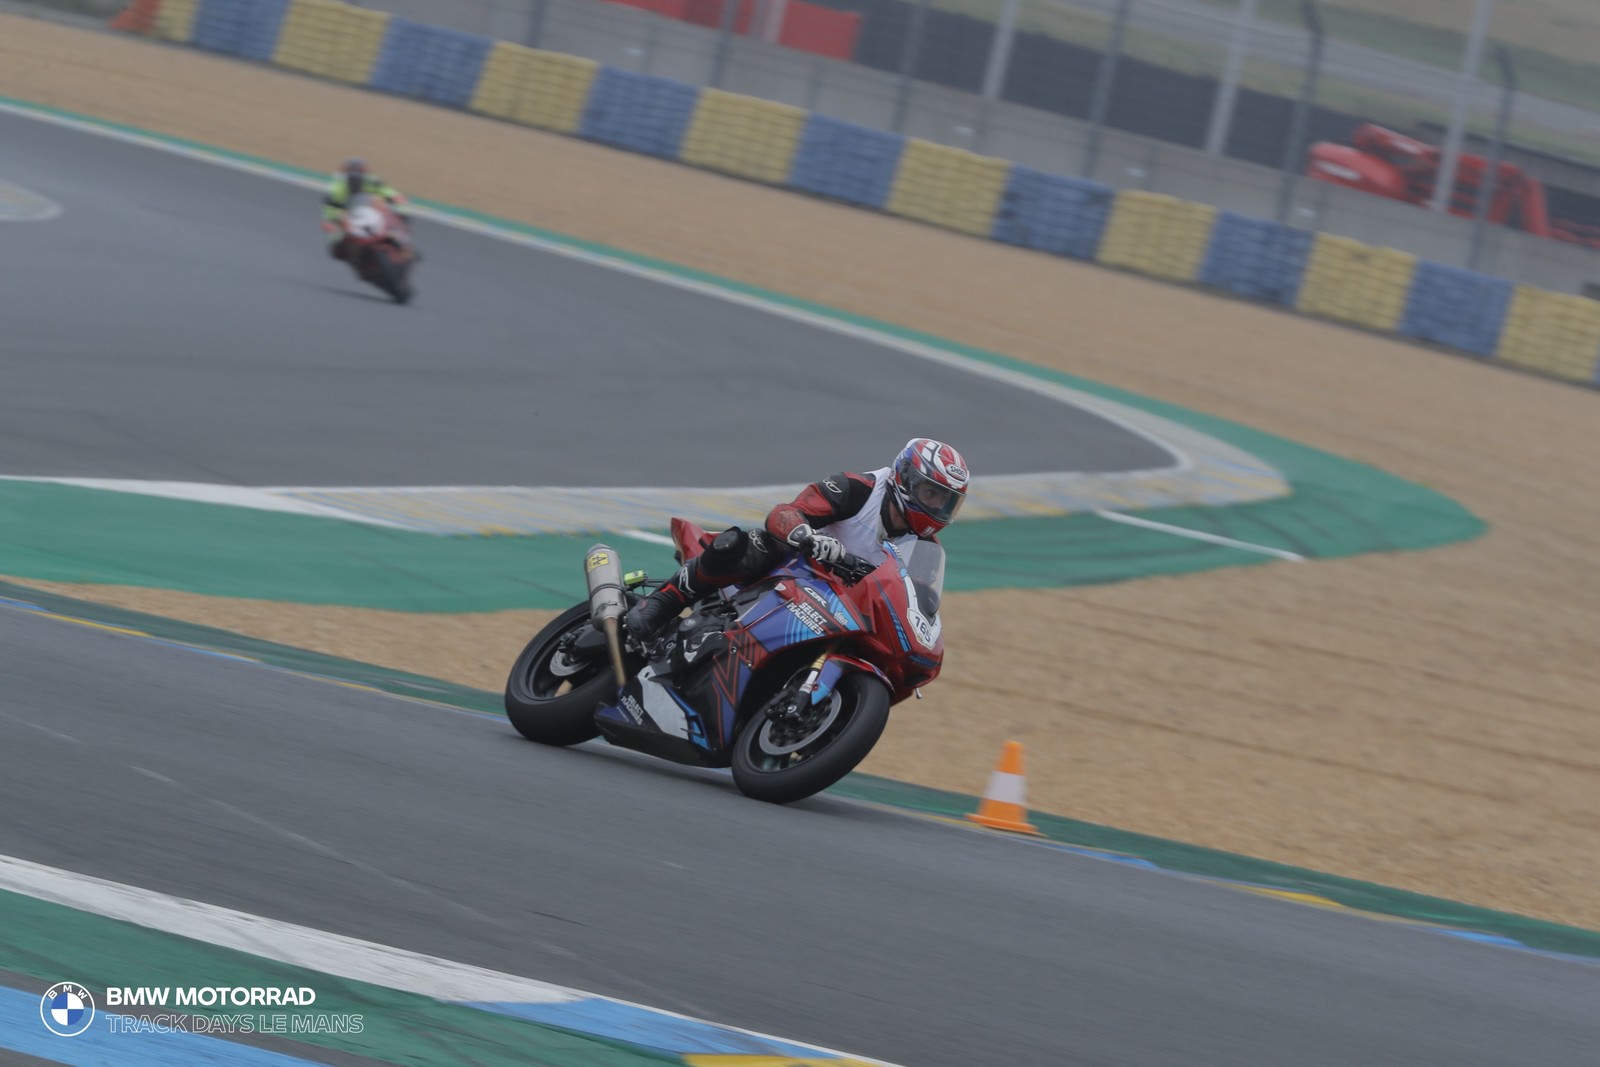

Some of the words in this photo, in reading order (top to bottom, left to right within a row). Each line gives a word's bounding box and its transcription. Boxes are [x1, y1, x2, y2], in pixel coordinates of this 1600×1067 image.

[803, 586, 828, 608] CBR
[786, 602, 824, 636] MACHINES
[798, 601, 827, 625] SELECT
[914, 615, 931, 643] 165
[627, 694, 644, 716] SELECT
